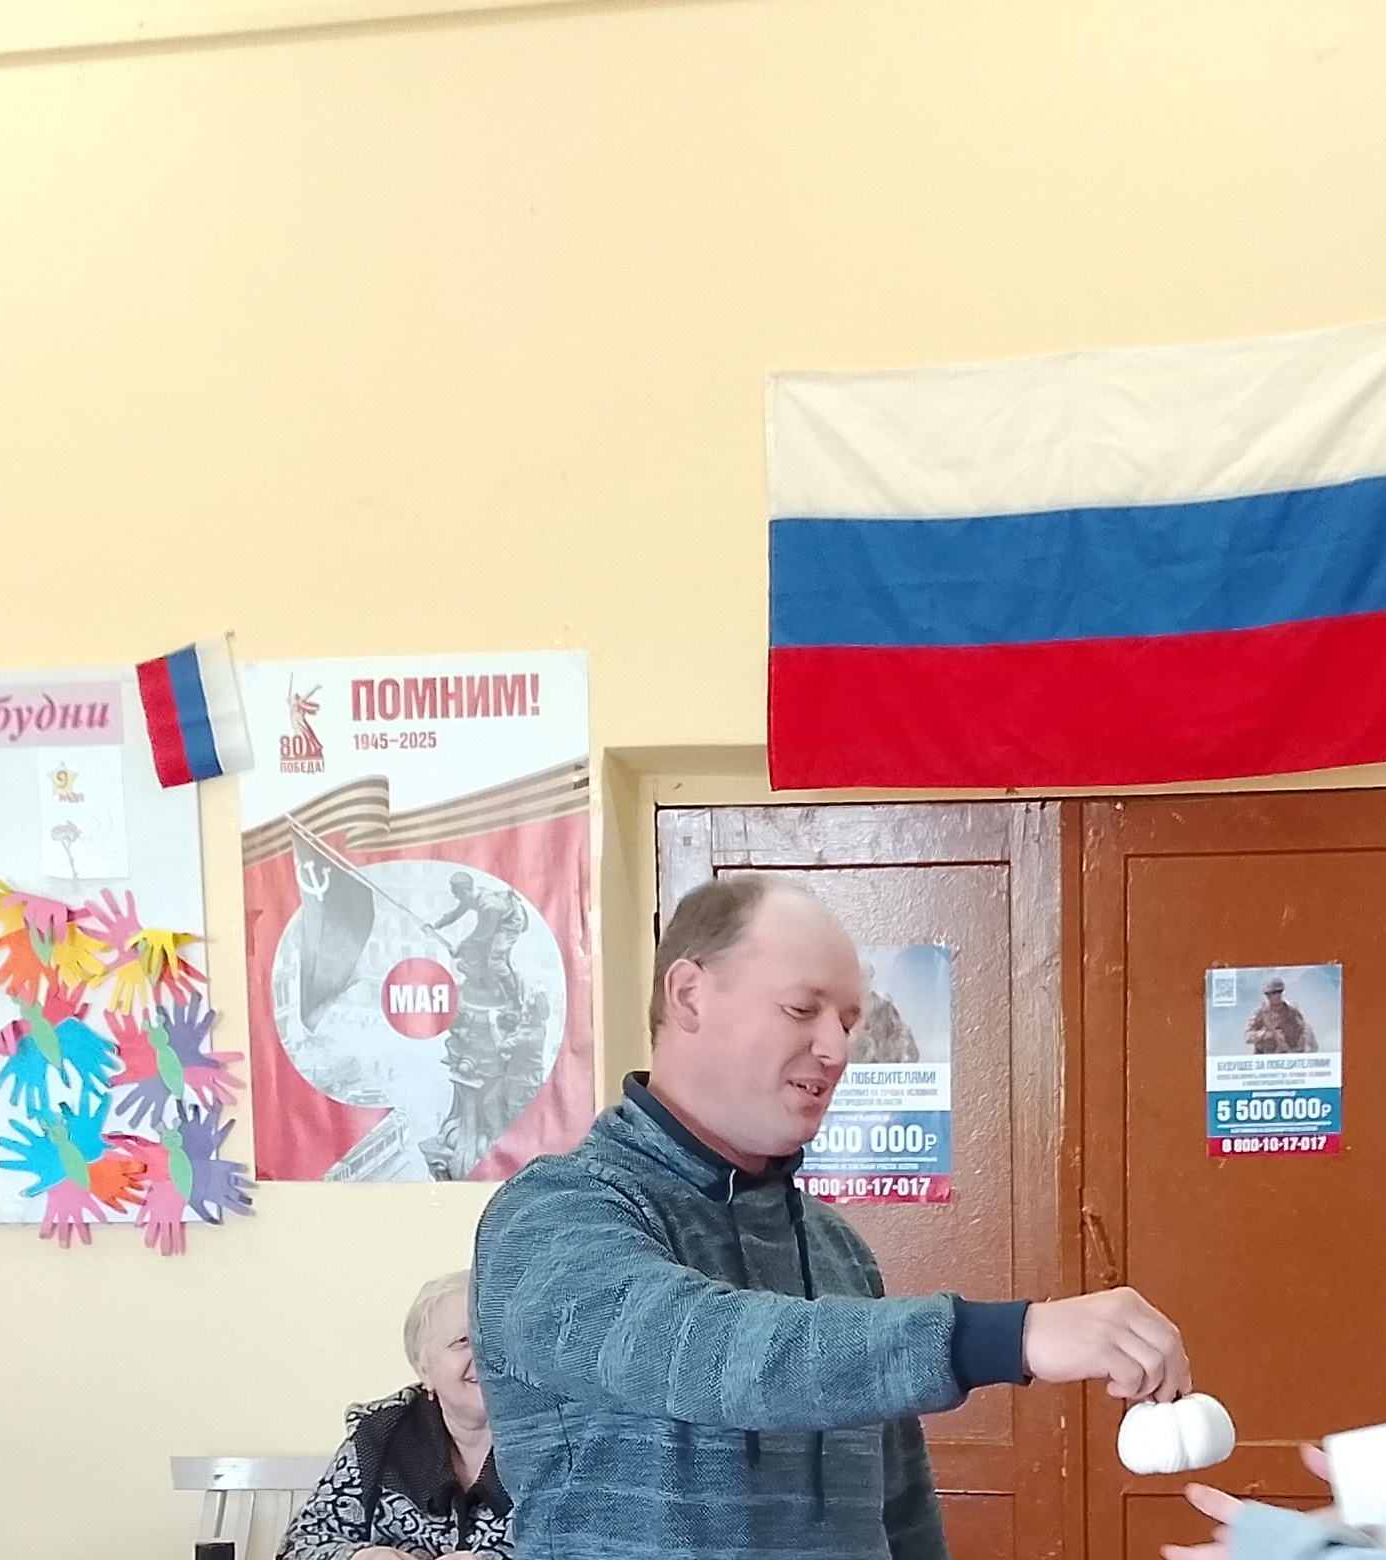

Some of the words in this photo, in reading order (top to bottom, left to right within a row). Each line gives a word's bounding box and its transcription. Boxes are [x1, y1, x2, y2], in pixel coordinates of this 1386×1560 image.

[351, 673, 540, 722] ПОМНИМ!
[280, 760, 325, 775] ПОБЕДА!
[389, 984, 449, 1013] МАЯ
[851, 1071, 937, 1086] ПОБЕДИТЕЛЯМИ!
[1217, 1100, 1231, 1121] 5
[1235, 1099, 1276, 1121] 500
[811, 1125, 862, 1153] 500
[809, 1177, 931, 1196] 800-10-17-017
